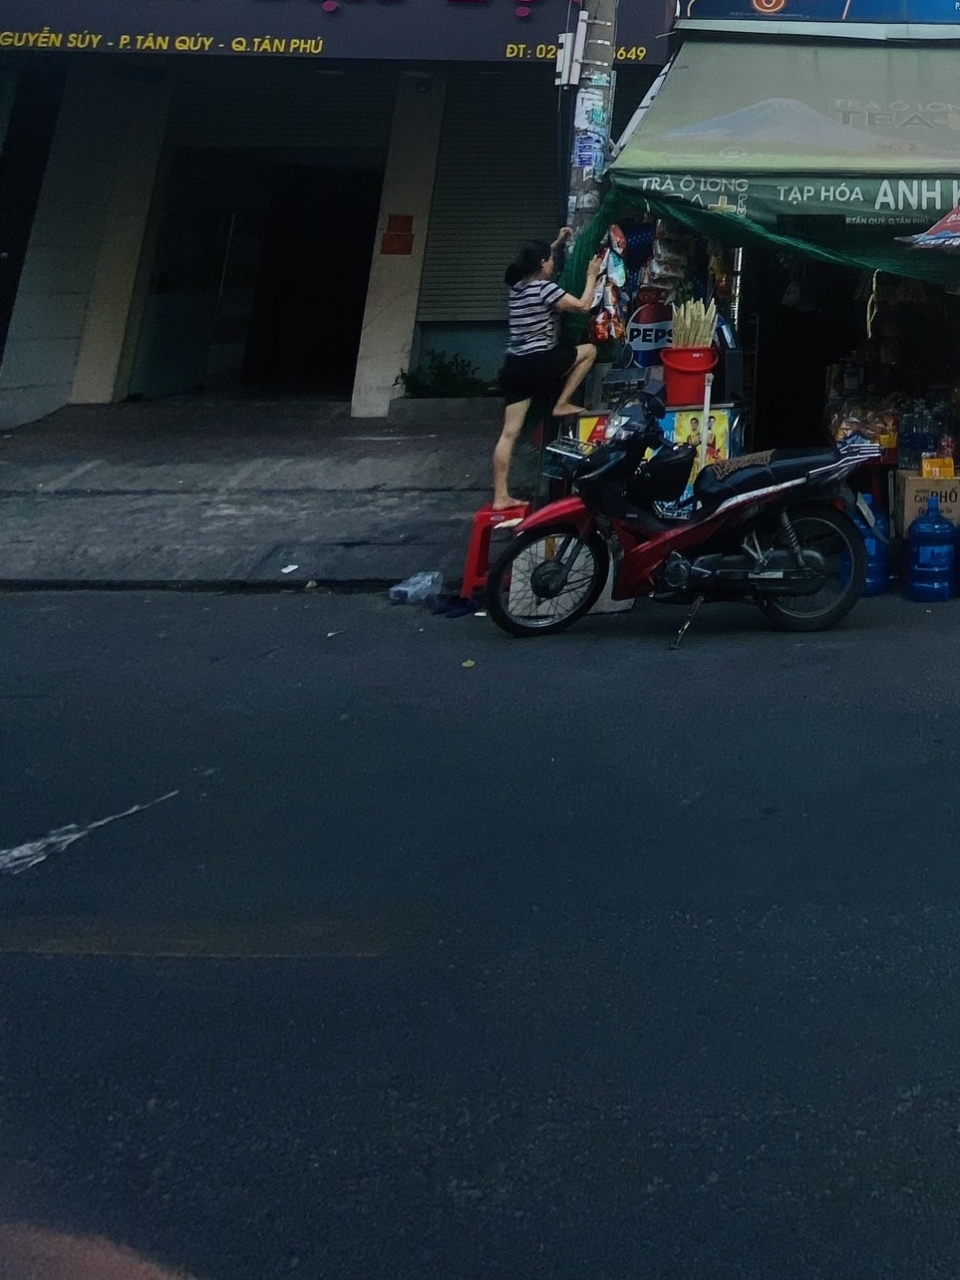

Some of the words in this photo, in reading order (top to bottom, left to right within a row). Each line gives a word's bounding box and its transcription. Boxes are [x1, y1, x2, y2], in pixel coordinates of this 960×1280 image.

[67, 31, 102, 48] SÚY
[289, 37, 323, 54] PHÚ
[639, 174, 675, 191] TRÀ
[680, 174, 696, 191] Ô
[700, 178, 749, 192] LONG
[776, 185, 815, 205] TẠP
[820, 182, 864, 202] HÓA
[874, 179, 942, 211] ANH
[629, 327, 673, 344] PEPS
